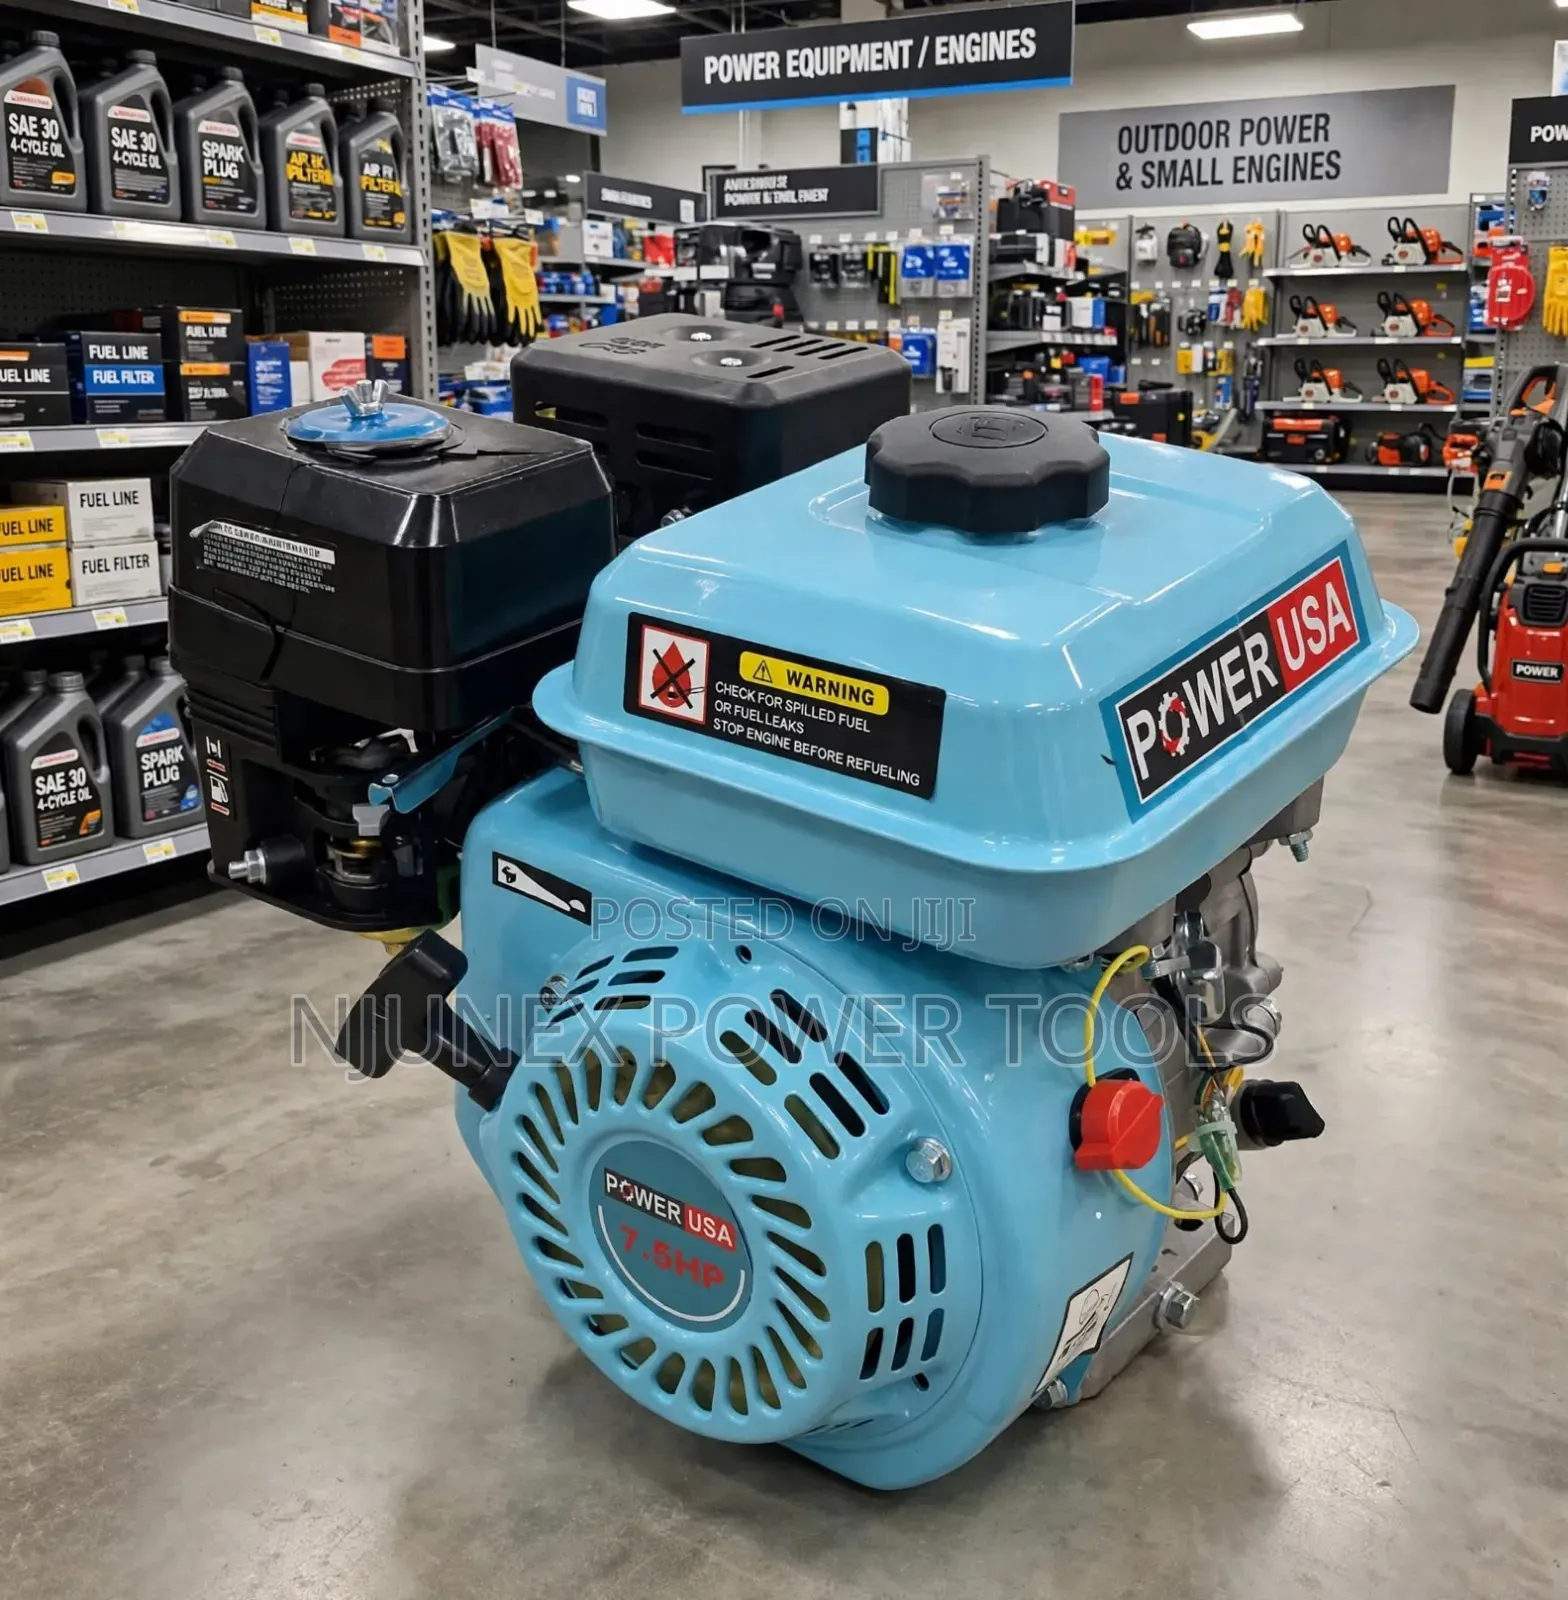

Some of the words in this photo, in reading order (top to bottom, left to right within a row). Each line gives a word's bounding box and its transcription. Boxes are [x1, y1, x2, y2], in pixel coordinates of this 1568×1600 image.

[704, 51, 781, 84] POWER
[786, 39, 914, 79] EQUIPMENT
[935, 27, 1037, 66] ENGINES
[8, 112, 39, 137] SAE
[41, 119, 59, 140] 30
[1118, 119, 1231, 155] OUTDOOR
[1239, 113, 1331, 147] POWER
[1530, 124, 1568, 143] POW
[10, 137, 49, 156] 4-CYCLE
[50, 142, 65, 158] OIL
[111, 126, 139, 150] SAE
[139, 131, 157, 153] 30
[202, 140, 244, 163] SPARK
[113, 150, 148, 168] 4-CYCLE
[148, 155, 162, 170] OIL
[204, 158, 240, 179] PLUG
[1115, 162, 1133, 191] &
[1141, 157, 1224, 189] SMALL
[1232, 149, 1342, 184] ENGINES
[88, 344, 120, 360] FUEL
[122, 345, 149, 360] LINE
[0, 368, 22, 383] UEL
[24, 368, 51, 383] LINE
[93, 370, 120, 384] FUEL
[121, 370, 155, 385] FILTER
[79, 492, 110, 508] FUEL
[112, 490, 140, 506] LINE
[0, 520, 25, 536] UEL
[28, 518, 54, 534] LINE
[0, 566, 25, 583] UEL
[28, 563, 54, 580] LINE
[82, 557, 111, 575] FUEL
[114, 553, 150, 571] FILTER
[1127, 631, 1279, 781] POWER
[1276, 581, 1352, 672] USA
[1515, 664, 1559, 679] POWER
[785, 668, 875, 708] WARNING
[714, 700, 732, 716] OR
[733, 704, 764, 724] FUEL
[765, 713, 805, 735] LEAKS
[715, 681, 756, 703] CHECK
[757, 691, 783, 709] FOR
[784, 697, 837, 723] SPILLED
[838, 712, 871, 734] FUEL
[141, 745, 185, 771] SPARK
[713, 718, 745, 738] STOP
[746, 728, 791, 751] ENGINE
[793, 740, 844, 766] BEFORE
[846, 754, 921, 787] REFUELING
[35, 771, 67, 796] SAE
[68, 767, 87, 788] 30
[143, 765, 181, 788] PLUG
[37, 791, 77, 811] 4-CYCLE
[77, 786, 93, 802] OIL
[605, 1172, 682, 1225] POWER
[688, 1209, 734, 1247] USA
